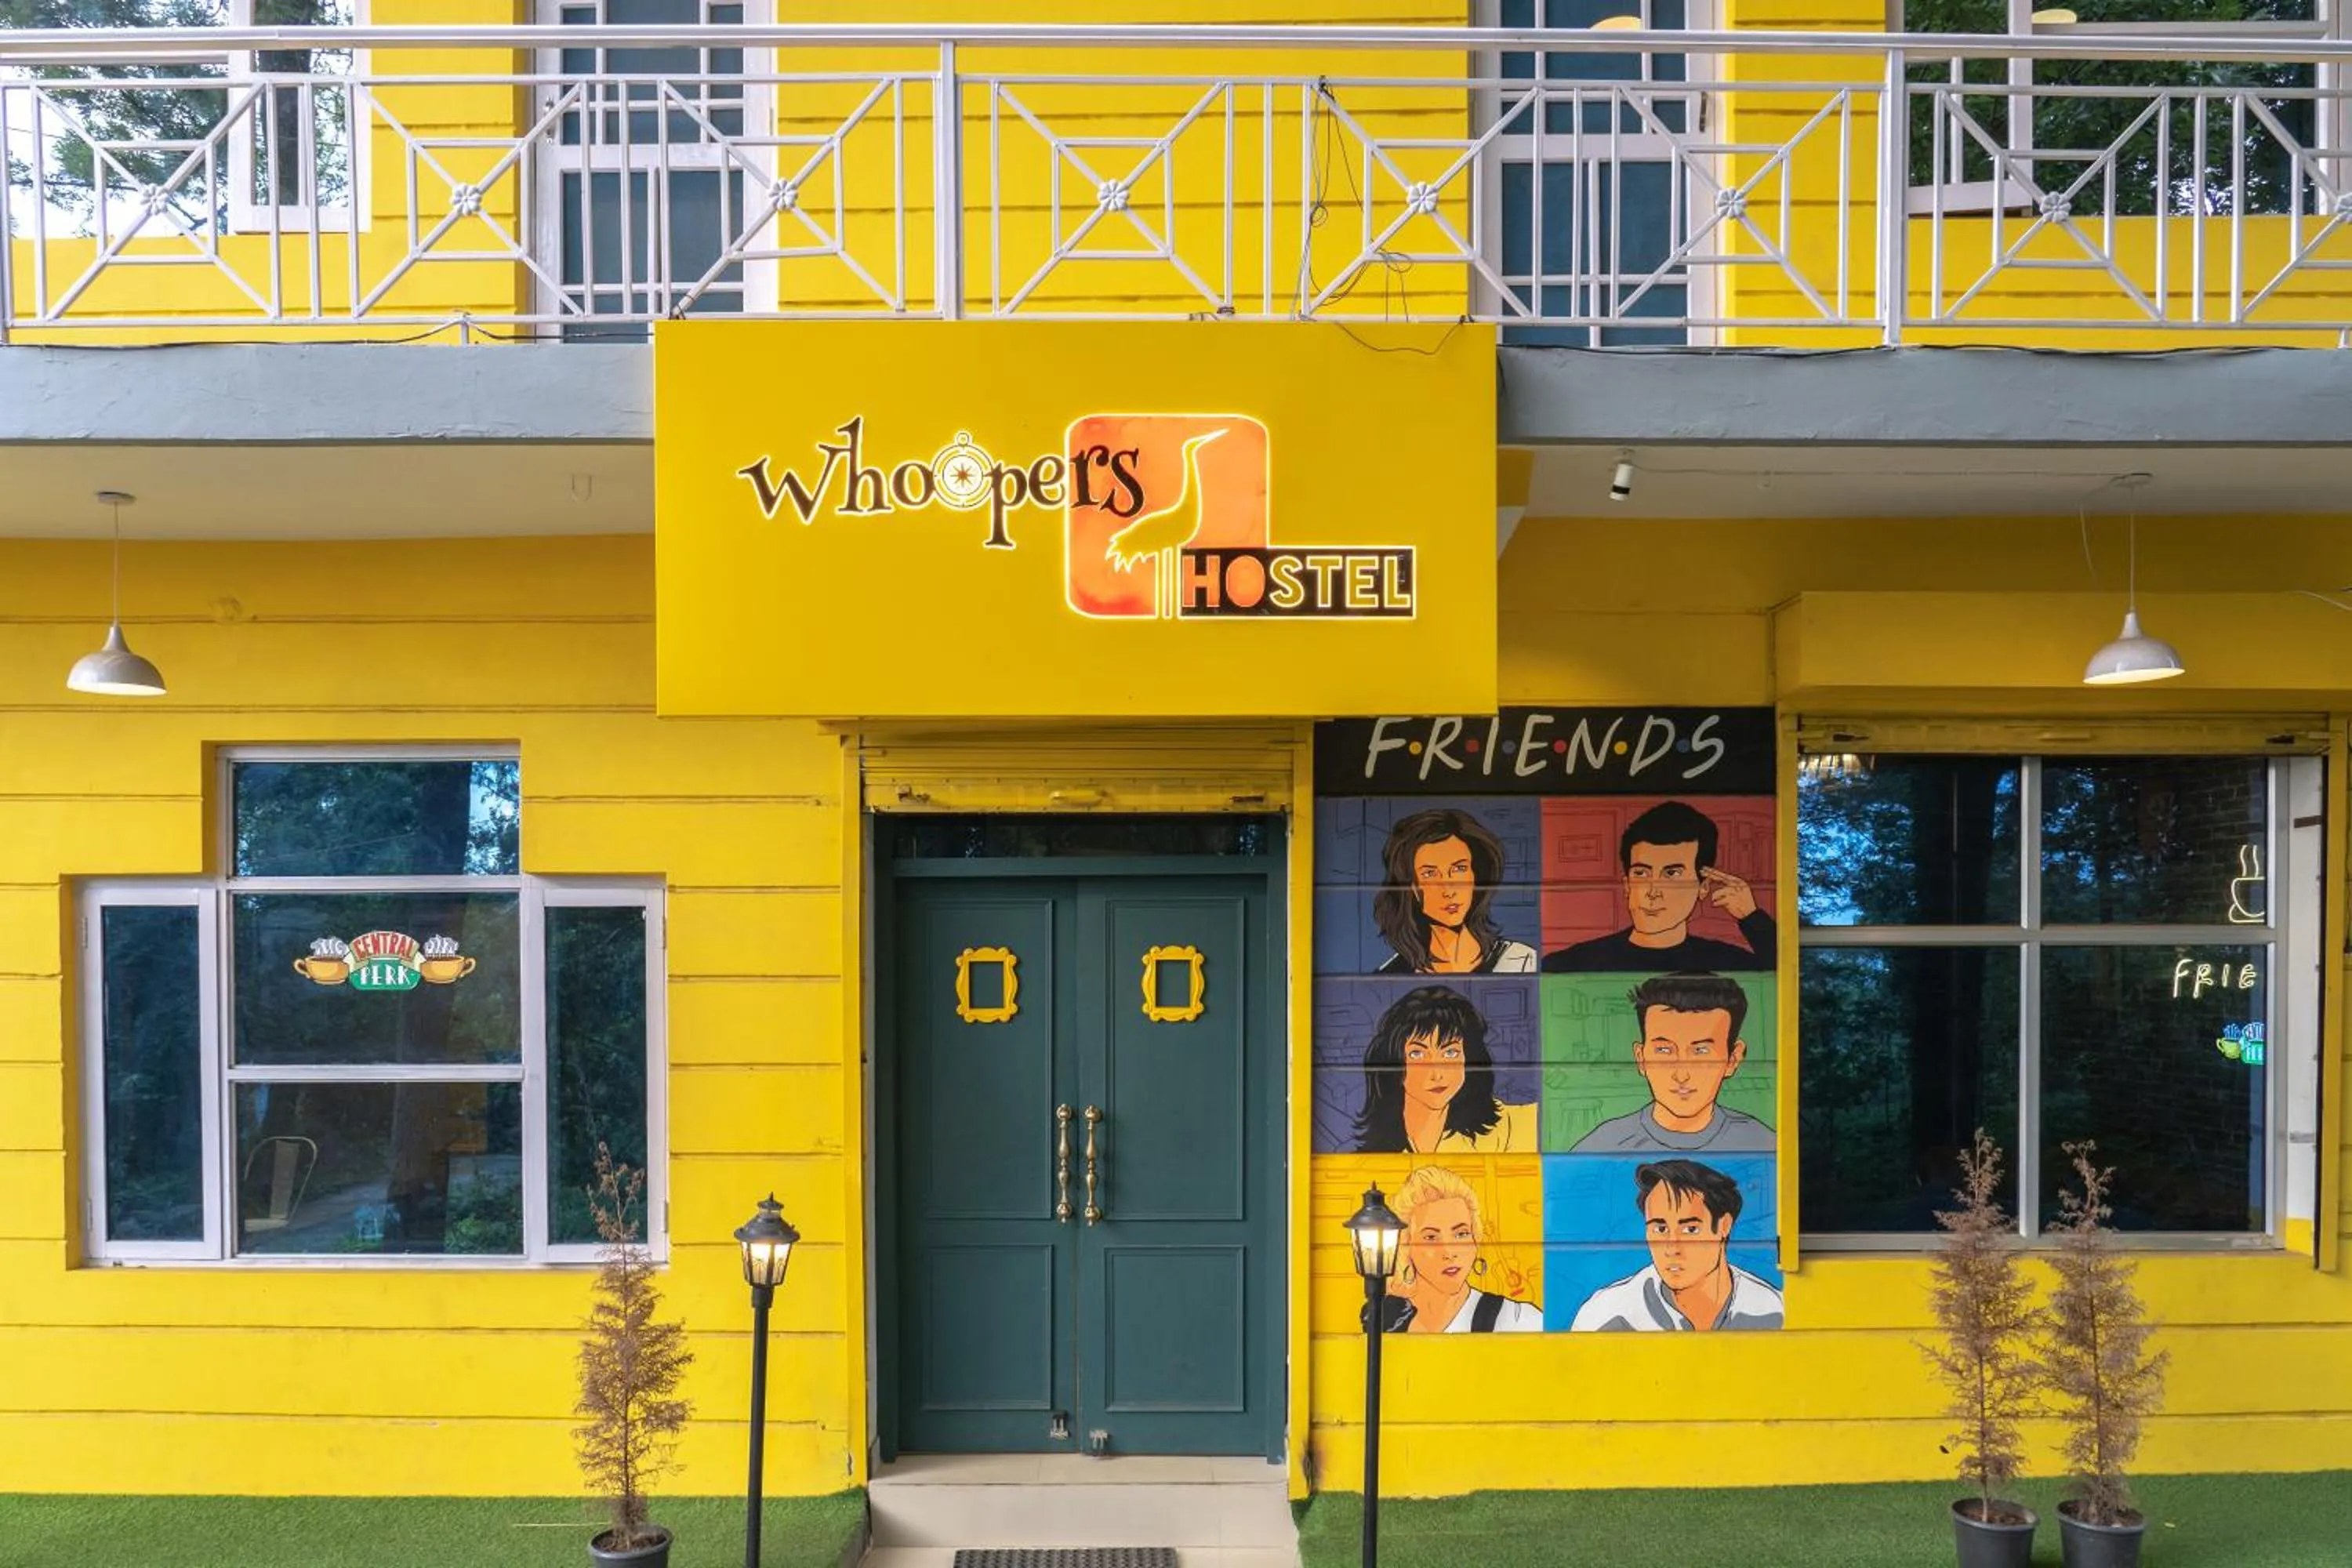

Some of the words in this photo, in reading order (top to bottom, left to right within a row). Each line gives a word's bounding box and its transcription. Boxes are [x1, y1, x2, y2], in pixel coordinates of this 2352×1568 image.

[1181, 554, 1412, 609] HOSTEL
[352, 931, 416, 962] CENTRAL
[360, 963, 411, 986] PERK
